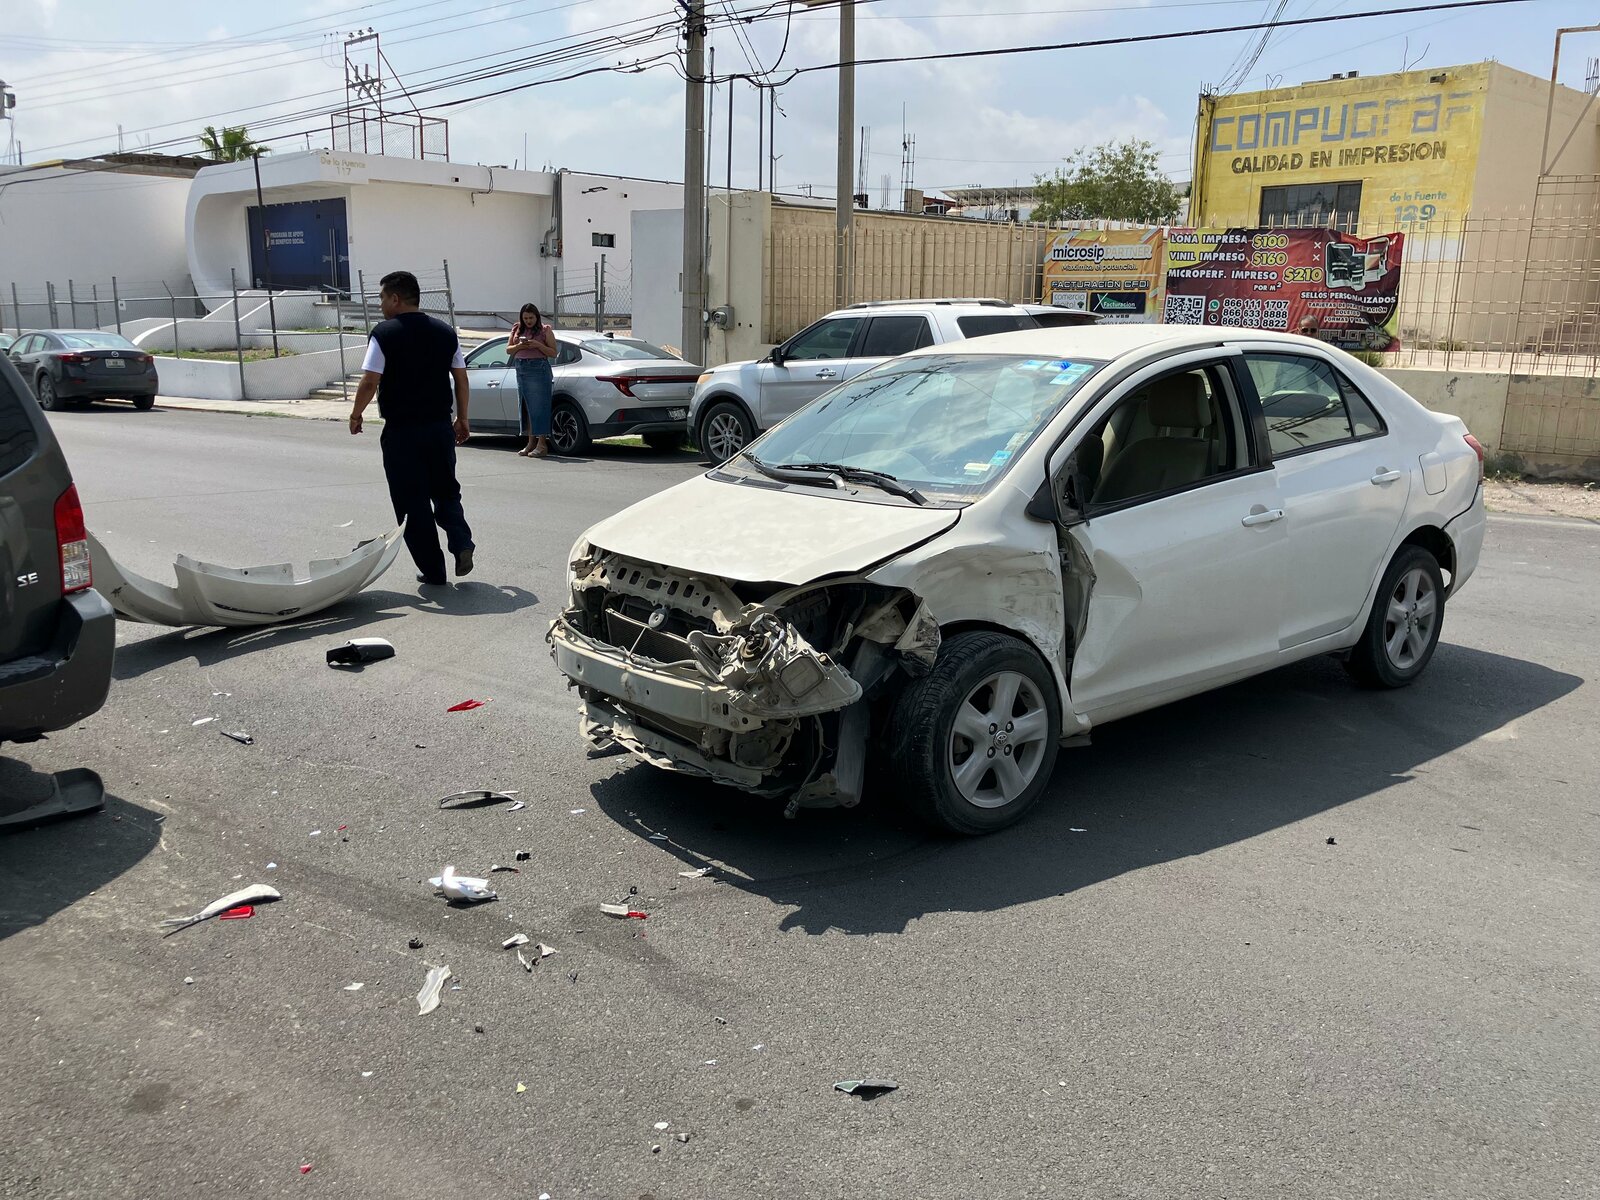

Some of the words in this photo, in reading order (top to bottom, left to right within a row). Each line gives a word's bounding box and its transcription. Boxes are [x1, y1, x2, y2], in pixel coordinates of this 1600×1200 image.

[1231, 153, 1303, 174] CALIDAD
[1309, 150, 1333, 168] EN
[1338, 141, 1447, 166] IMPRESION
[1390, 192, 1401, 202] de
[1404, 192, 1412, 201] la
[1414, 191, 1447, 201] Fuente
[1395, 204, 1436, 221] 129
[1170, 234, 1199, 244] LONA
[1202, 234, 1248, 244] IMPRESA
[1252, 234, 1289, 249] $100
[1053, 245, 1104, 260] microsip
[1105, 246, 1151, 257] PARTNER
[1169, 251, 1196, 261] VINIL
[1199, 251, 1246, 262] IMPRESO
[1252, 252, 1288, 266] $160
[1168, 268, 1227, 279] MICROPERF.
[1231, 270, 1278, 280] IMPRESO
[1283, 267, 1323, 282] $210
[1124, 280, 1150, 288] CFDI
[1300, 291, 1328, 299] SELLOS
[1244, 300, 1261, 308] 111
[1264, 301, 1289, 309] 1707
[1222, 309, 1241, 317] 866
[1263, 311, 1288, 319] 8888
[1222, 318, 1240, 326] 866
[1242, 319, 1260, 327] 633
[1262, 320, 1287, 328] 8822
[17, 572, 39, 587] SE
